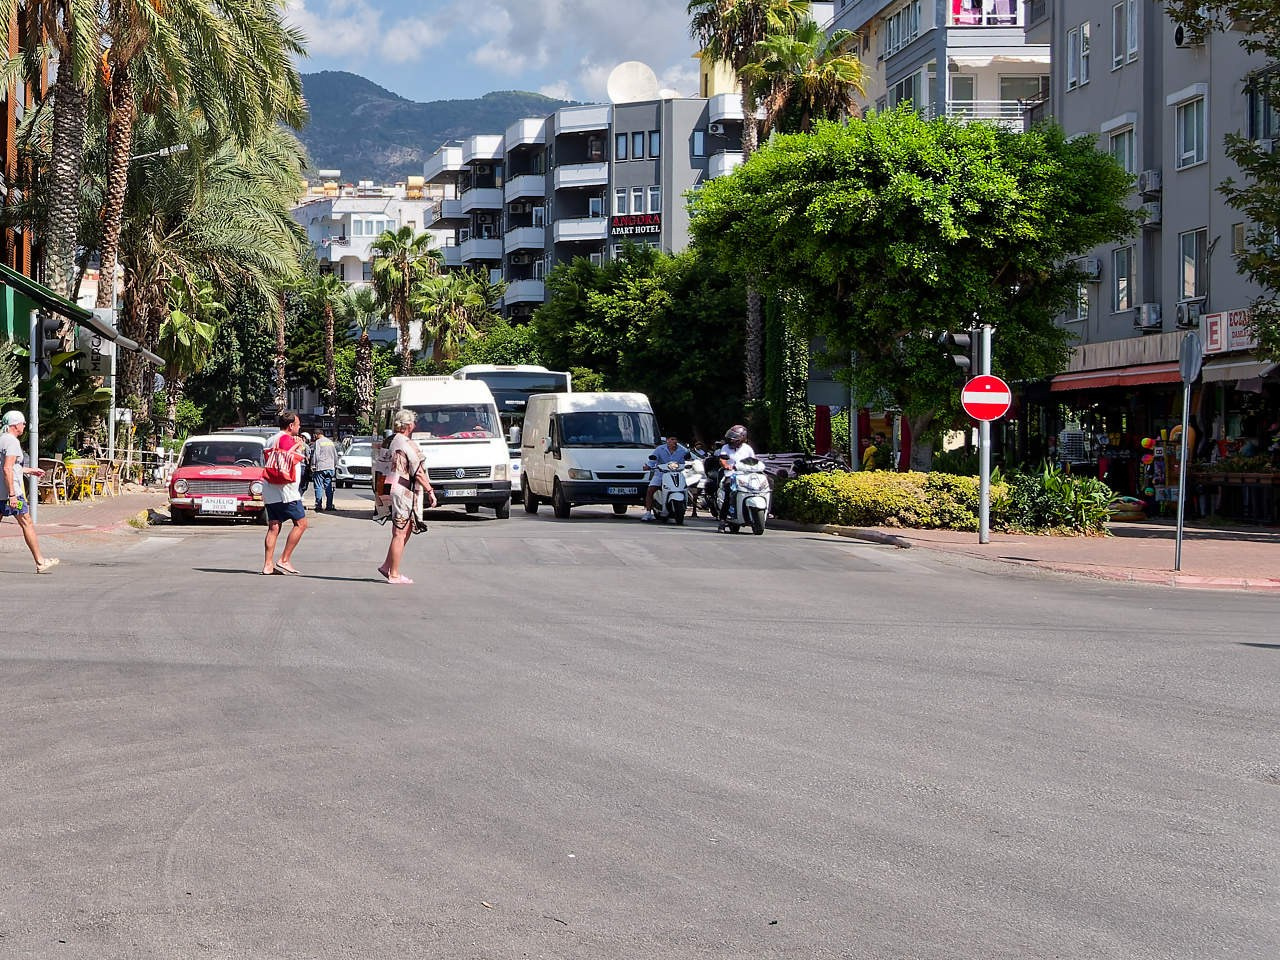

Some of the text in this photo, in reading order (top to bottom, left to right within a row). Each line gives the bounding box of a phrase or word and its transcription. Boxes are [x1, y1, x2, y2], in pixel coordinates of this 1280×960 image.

[612, 214, 661, 227] ANGORA
[611, 225, 661, 235] APART HOTEL
[1209, 321, 1219, 345] E
